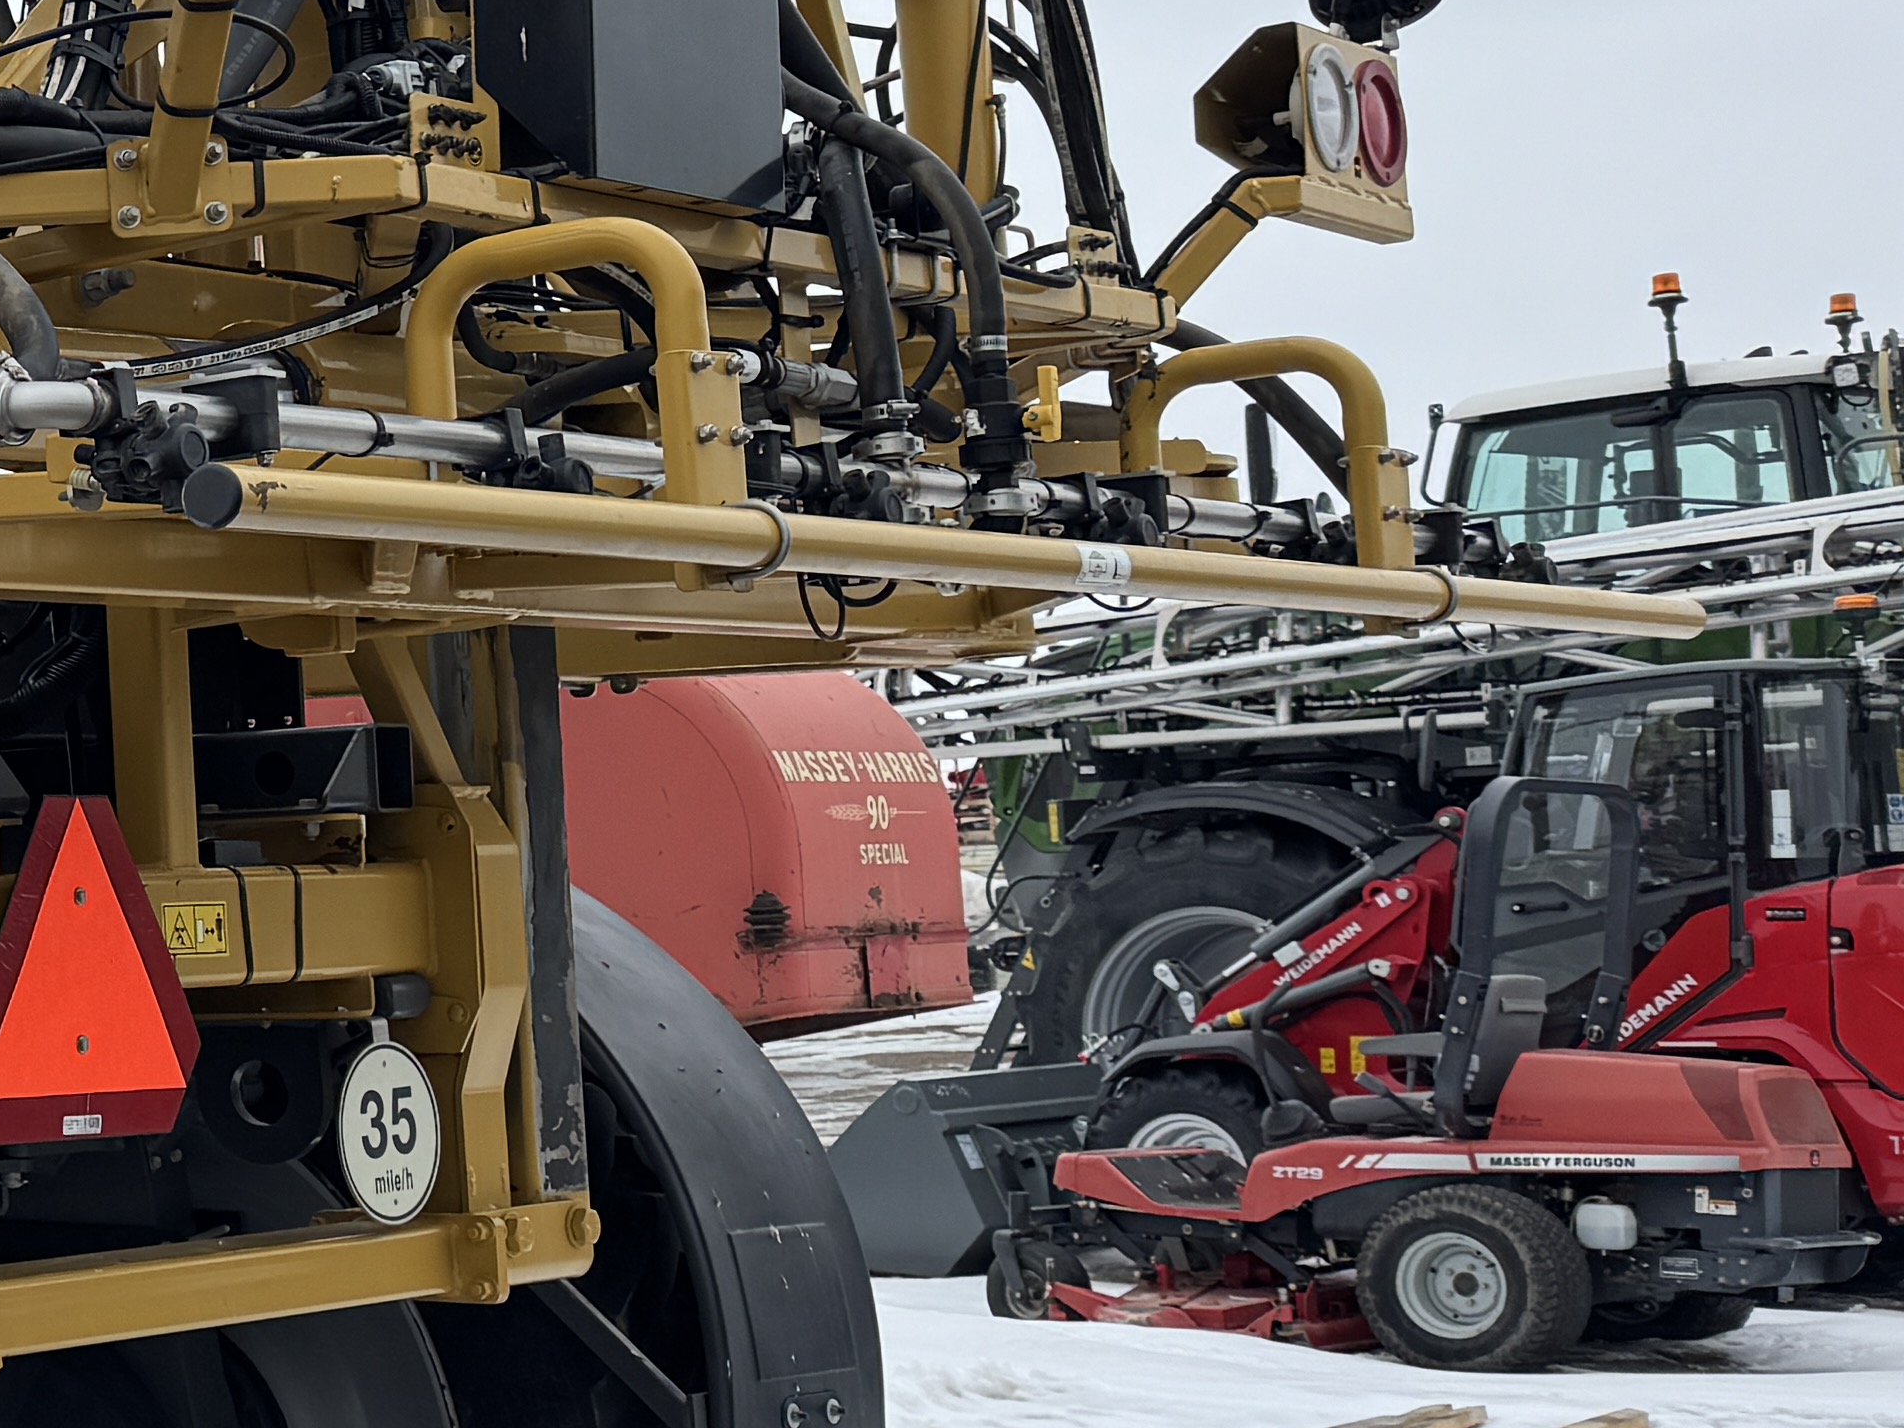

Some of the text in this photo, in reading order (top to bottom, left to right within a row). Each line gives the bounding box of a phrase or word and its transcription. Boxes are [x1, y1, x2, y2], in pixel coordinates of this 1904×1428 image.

[771, 749, 939, 783] MASSEY-HARRIS
[866, 794, 890, 830] 90
[859, 842, 910, 865] SPECIAL
[1272, 921, 1363, 987] WEIDEMANN
[1616, 972, 1699, 1043] DEMANN
[360, 1086, 417, 1159] 35
[1272, 1165, 1324, 1180] ZT29
[1490, 1156, 1636, 1169] MASSEY FERGUSON
[375, 1167, 414, 1194] mile/h
